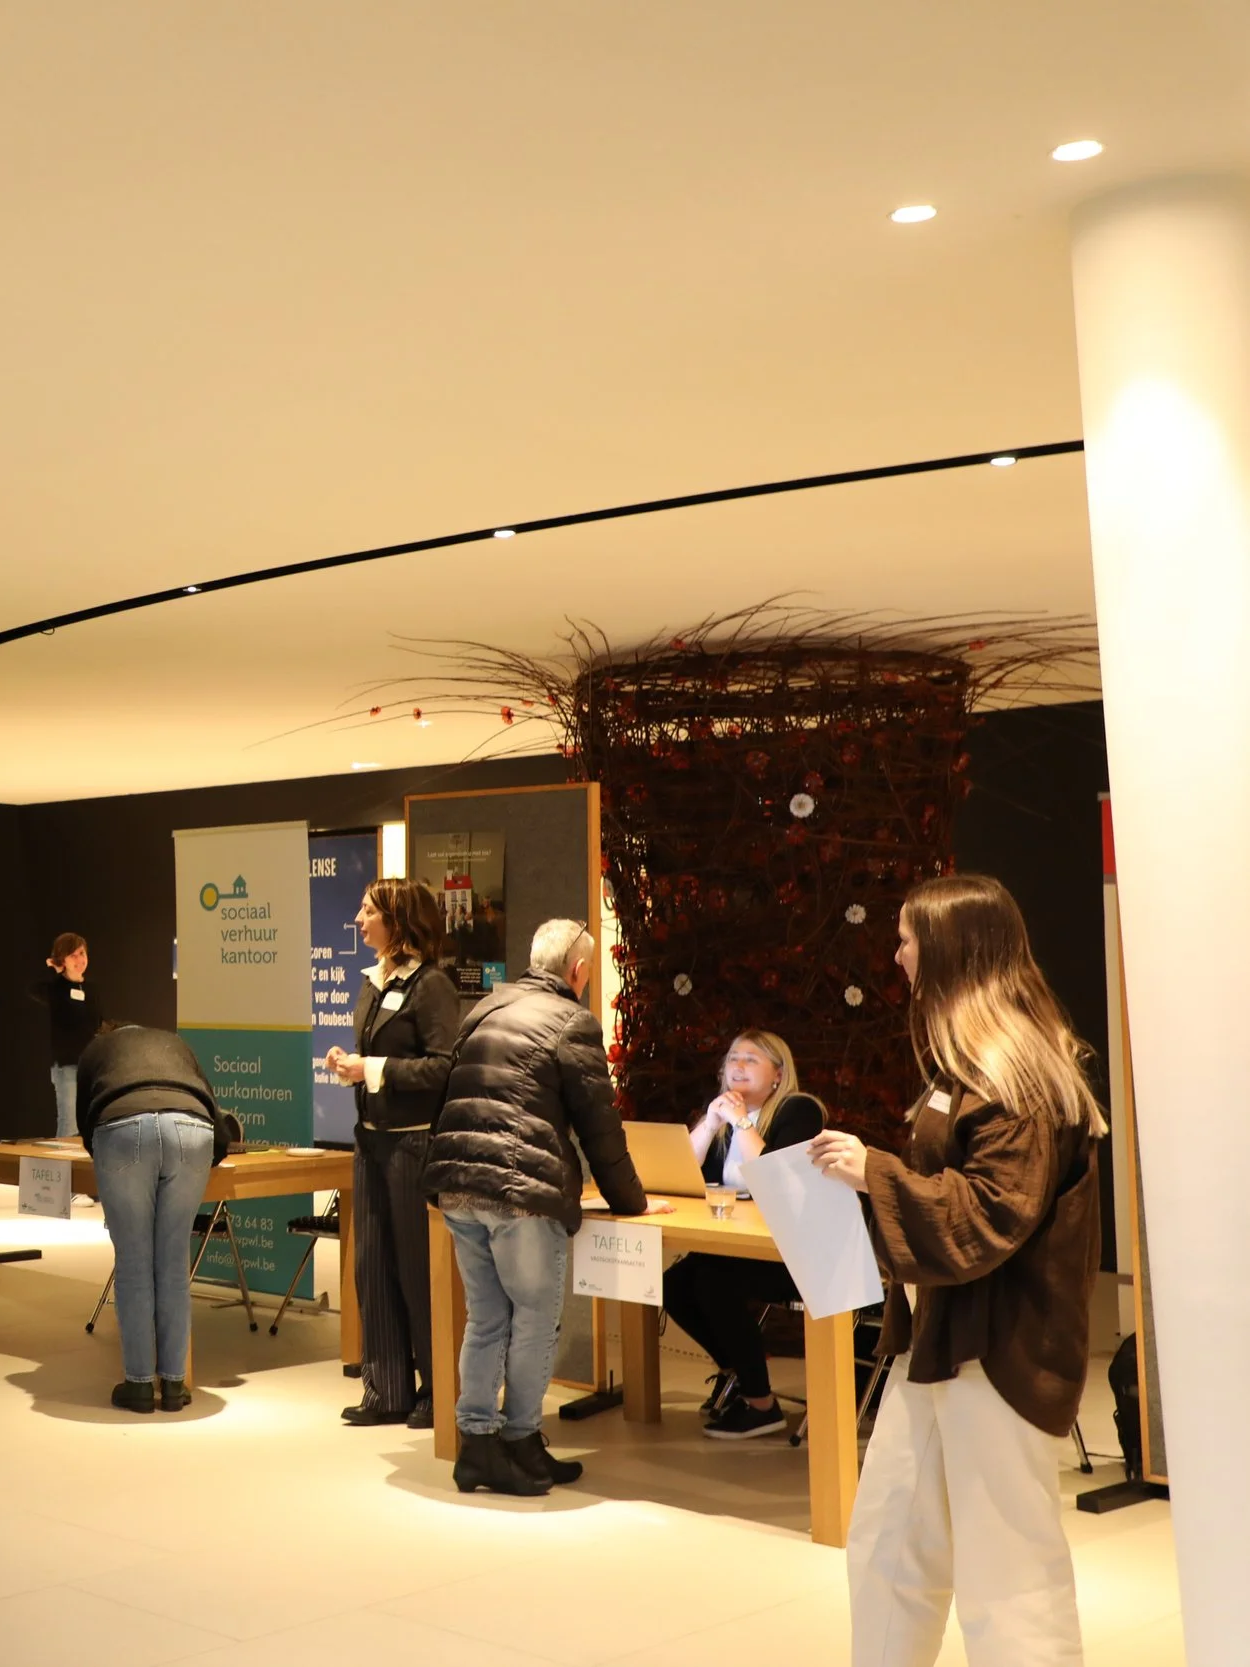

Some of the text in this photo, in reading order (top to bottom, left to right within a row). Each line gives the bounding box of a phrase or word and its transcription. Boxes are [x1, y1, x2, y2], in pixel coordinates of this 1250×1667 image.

[310, 857, 337, 878] ENSE
[221, 901, 271, 920] sociaal
[221, 924, 278, 942] verhuur
[221, 947, 278, 964] kantoor
[318, 969, 329, 982] en
[330, 965, 346, 985] kijk
[330, 988, 350, 1004] door
[318, 1010, 354, 1027] Daubechi
[213, 1055, 262, 1074] Sociaal
[212, 1080, 293, 1102] uurkantoren
[32, 1168, 62, 1183] TAFEL 3
[260, 1217, 274, 1231] 83
[592, 1234, 643, 1255] TAFEL 4
